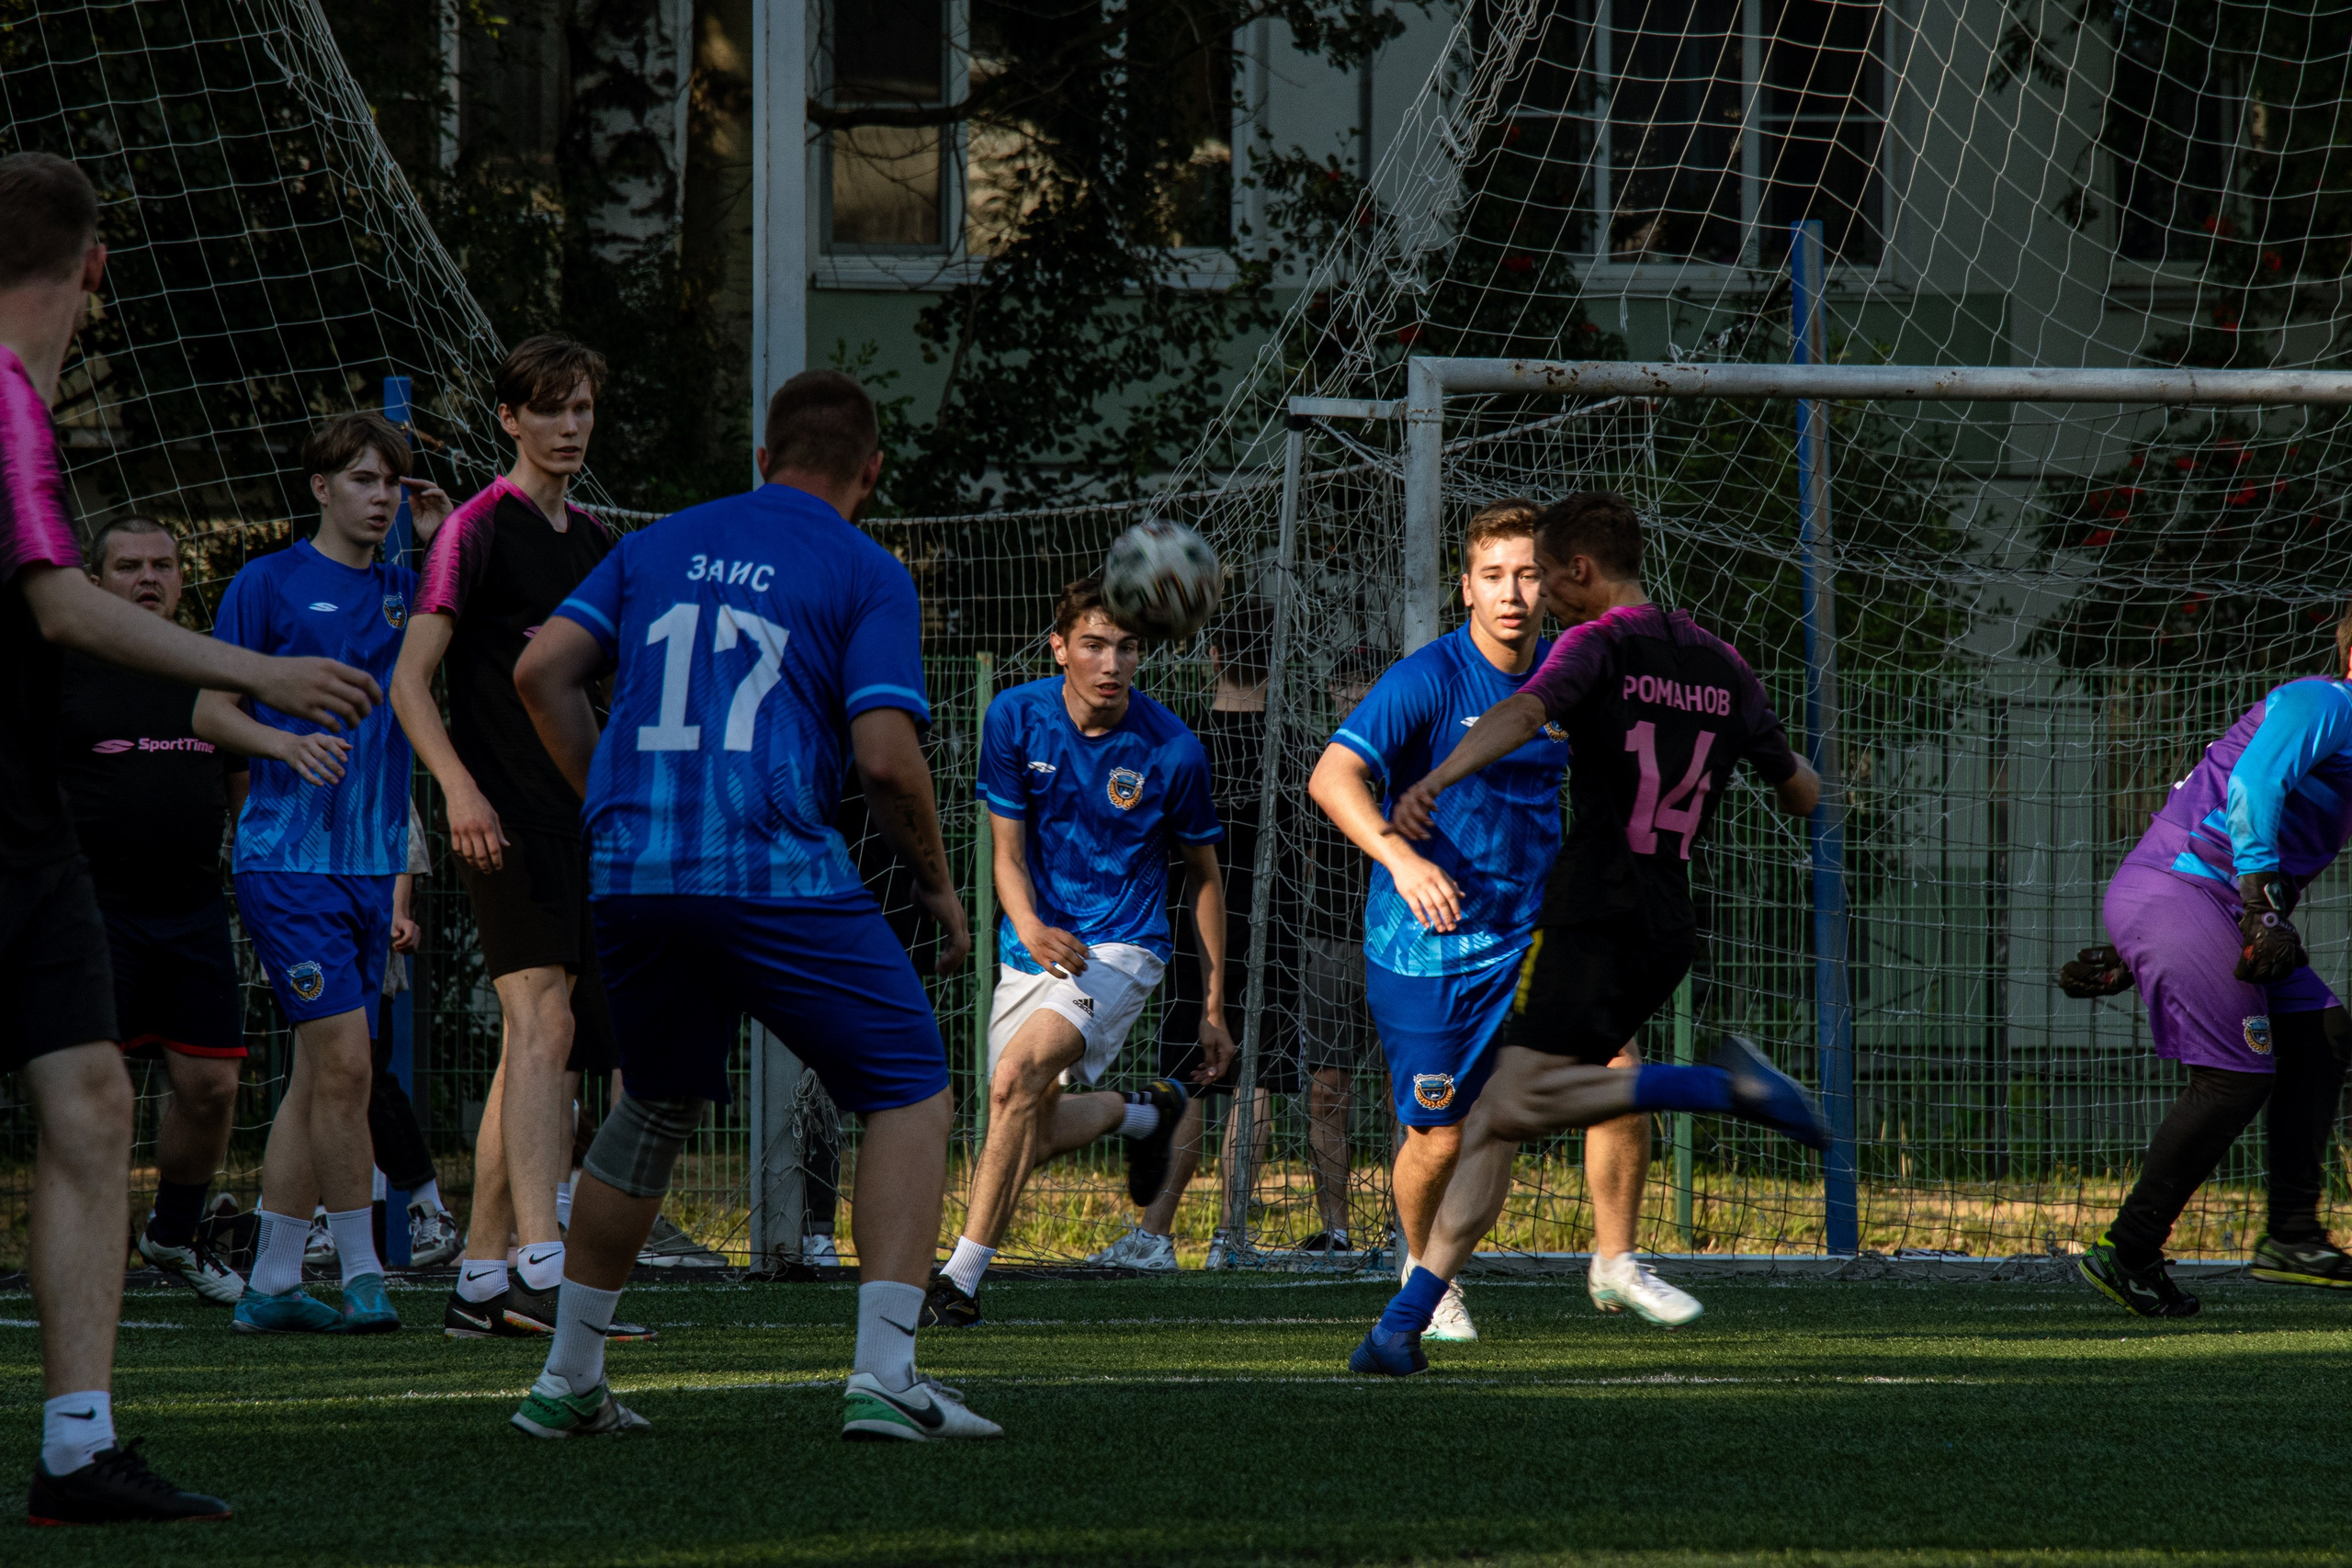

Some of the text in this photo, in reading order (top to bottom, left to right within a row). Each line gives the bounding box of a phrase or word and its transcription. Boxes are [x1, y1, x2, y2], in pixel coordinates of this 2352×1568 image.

[686, 554, 775, 592] ЗАИС
[637, 603, 790, 751] 17
[1623, 675, 1731, 716] РОМАНОВ
[138, 738, 215, 754] SportTime
[1624, 720, 1716, 861] 14
[1072, 999, 1094, 1019] adidas
